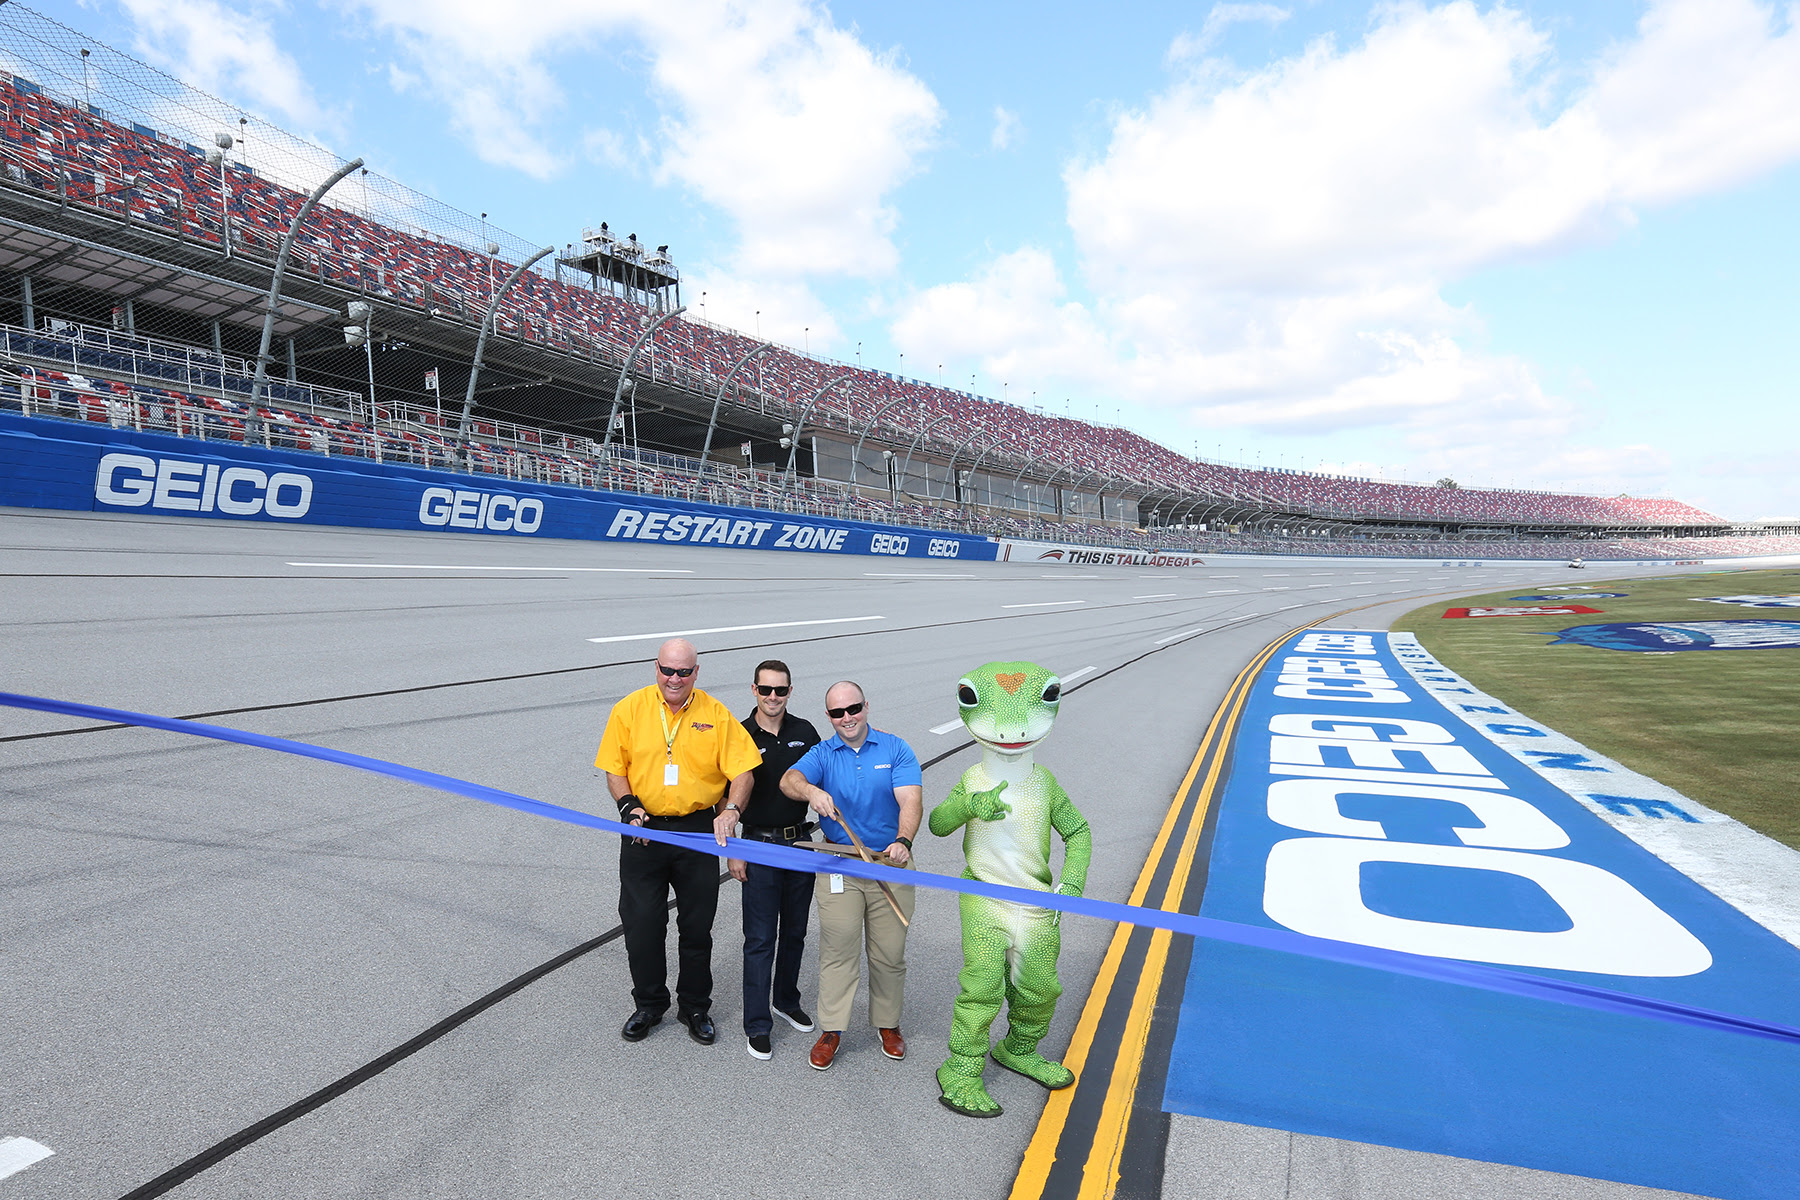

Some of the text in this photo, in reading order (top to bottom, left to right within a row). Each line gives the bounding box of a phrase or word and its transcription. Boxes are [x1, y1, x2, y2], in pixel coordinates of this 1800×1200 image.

[96, 453, 313, 518] GEICO
[419, 487, 544, 533] GEICO
[606, 508, 849, 550] RESTART ZONE
[870, 533, 909, 555] GEICO
[928, 538, 960, 558] GEICO
[1068, 551, 1190, 567] THIS IS TALLADEGA
[1273, 656, 1412, 703] GEICO
[1460, 704, 1704, 823] ZONE
[1263, 714, 1713, 977] GEICO
